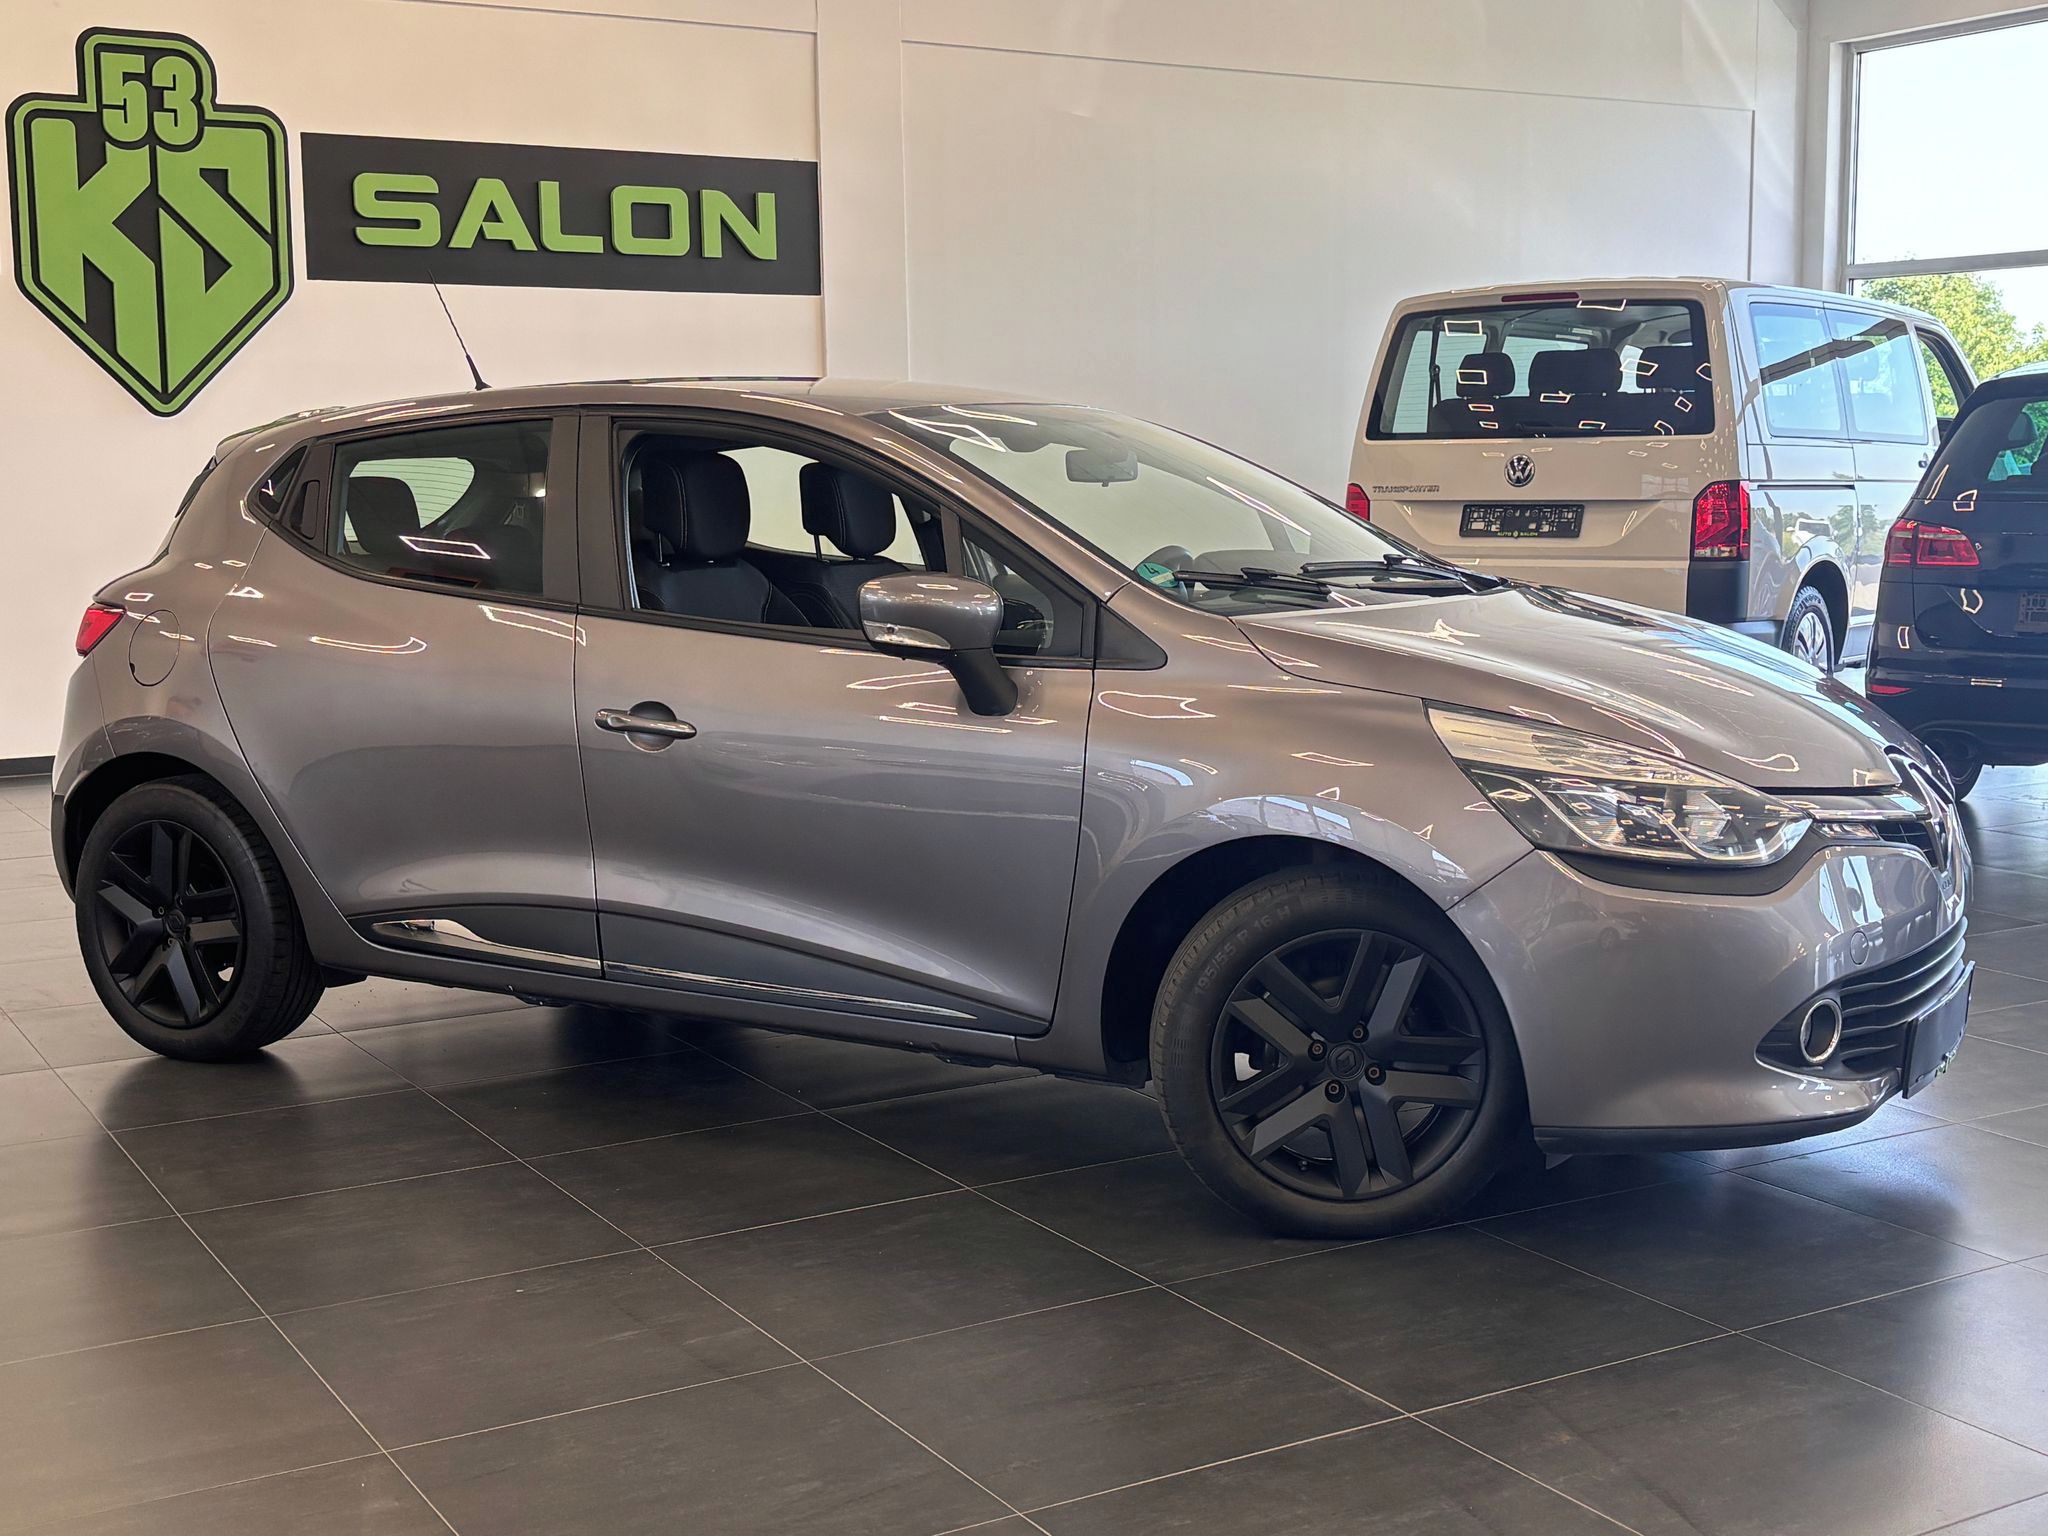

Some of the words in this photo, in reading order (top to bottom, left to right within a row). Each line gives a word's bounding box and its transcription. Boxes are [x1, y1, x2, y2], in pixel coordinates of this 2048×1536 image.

[100, 51, 199, 146] 53
[352, 172, 779, 261] SALON
[1372, 484, 1440, 494] TRANSPORTER
[1143, 563, 1160, 575] 4
[1252, 914, 1273, 932] 16
